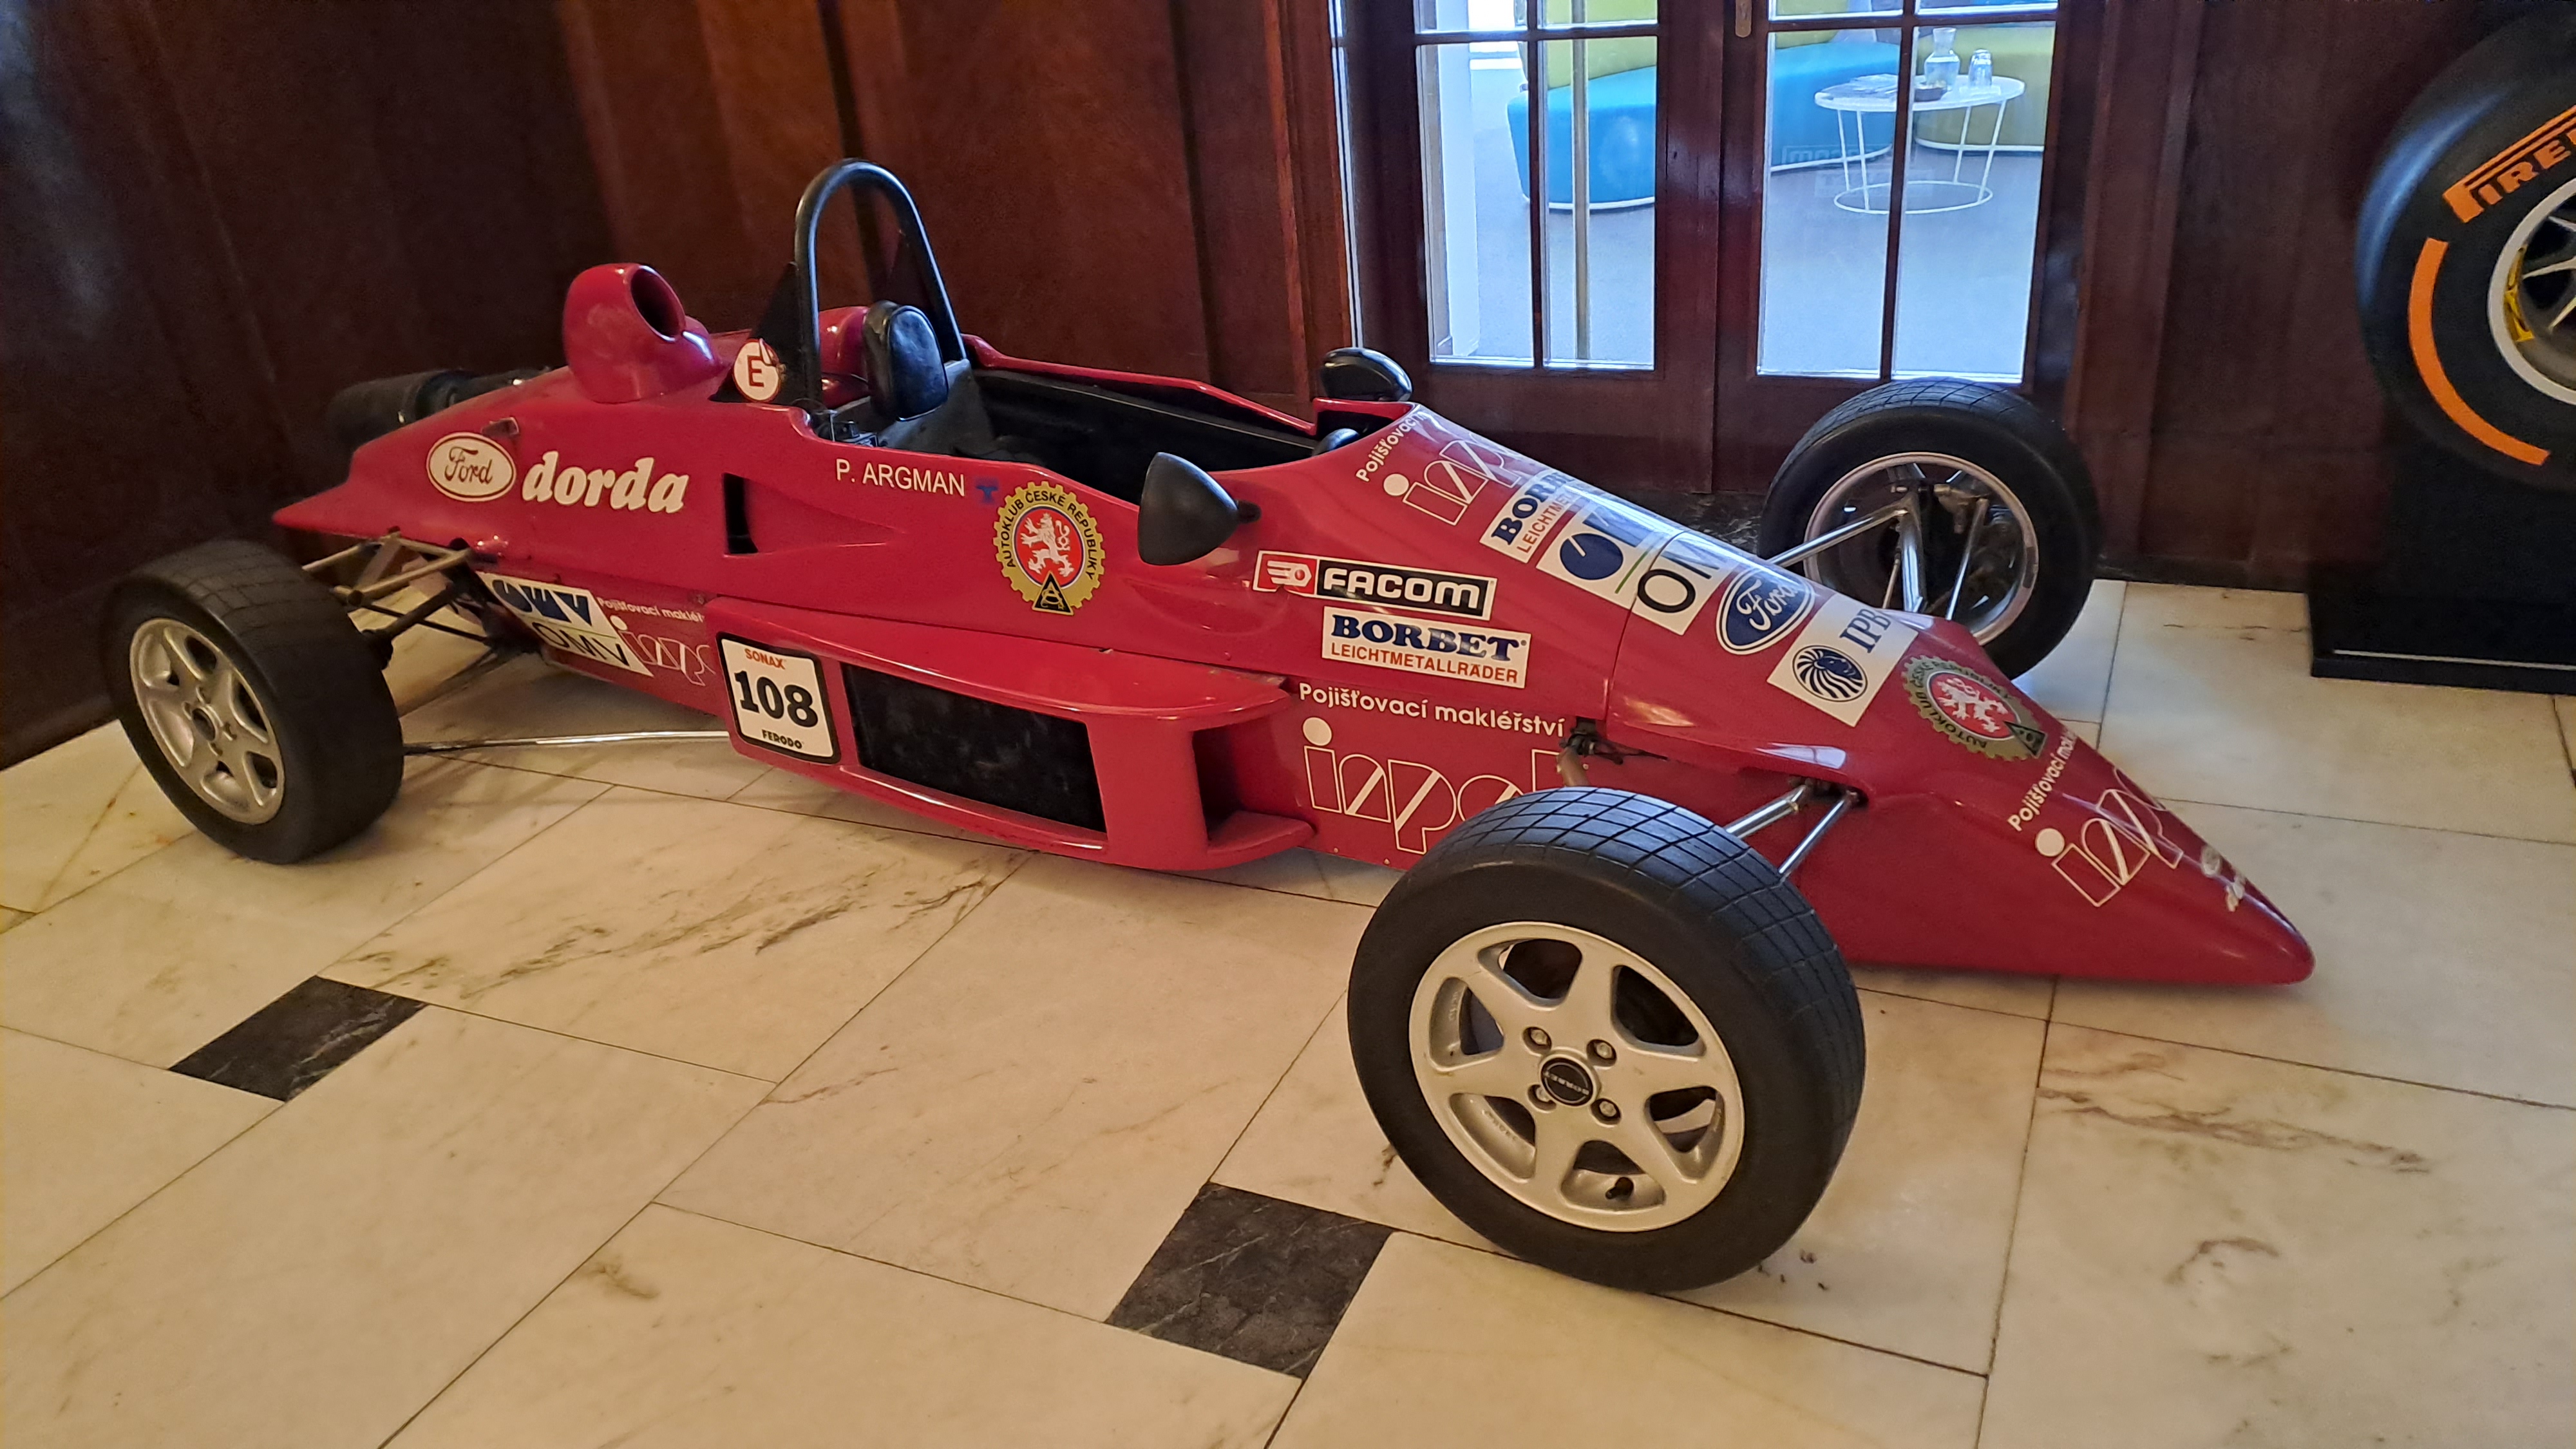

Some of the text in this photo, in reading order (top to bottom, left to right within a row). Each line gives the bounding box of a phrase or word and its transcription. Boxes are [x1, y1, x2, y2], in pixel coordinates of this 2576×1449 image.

[747, 355, 765, 387] E
[444, 446, 493, 484] Ford
[522, 451, 689, 513] dorda
[836, 458, 965, 497] P. ARGMAN
[1001, 490, 1097, 580] AUTOKLUB ČESKÉ REPUBLIKY
[1323, 567, 1481, 609] FACOM
[531, 622, 630, 667] OMV
[1331, 614, 1519, 661] BORBET
[1839, 609, 1892, 653] IPB
[744, 648, 786, 670] SONAX
[1331, 642, 1518, 683] LEICHTMETALLRÄDER
[734, 670, 819, 728] 108
[1298, 683, 1566, 737] Pojišťovací makléřství
[1916, 691, 1987, 748] AUTOKLUB
[762, 729, 802, 749] FERODO
